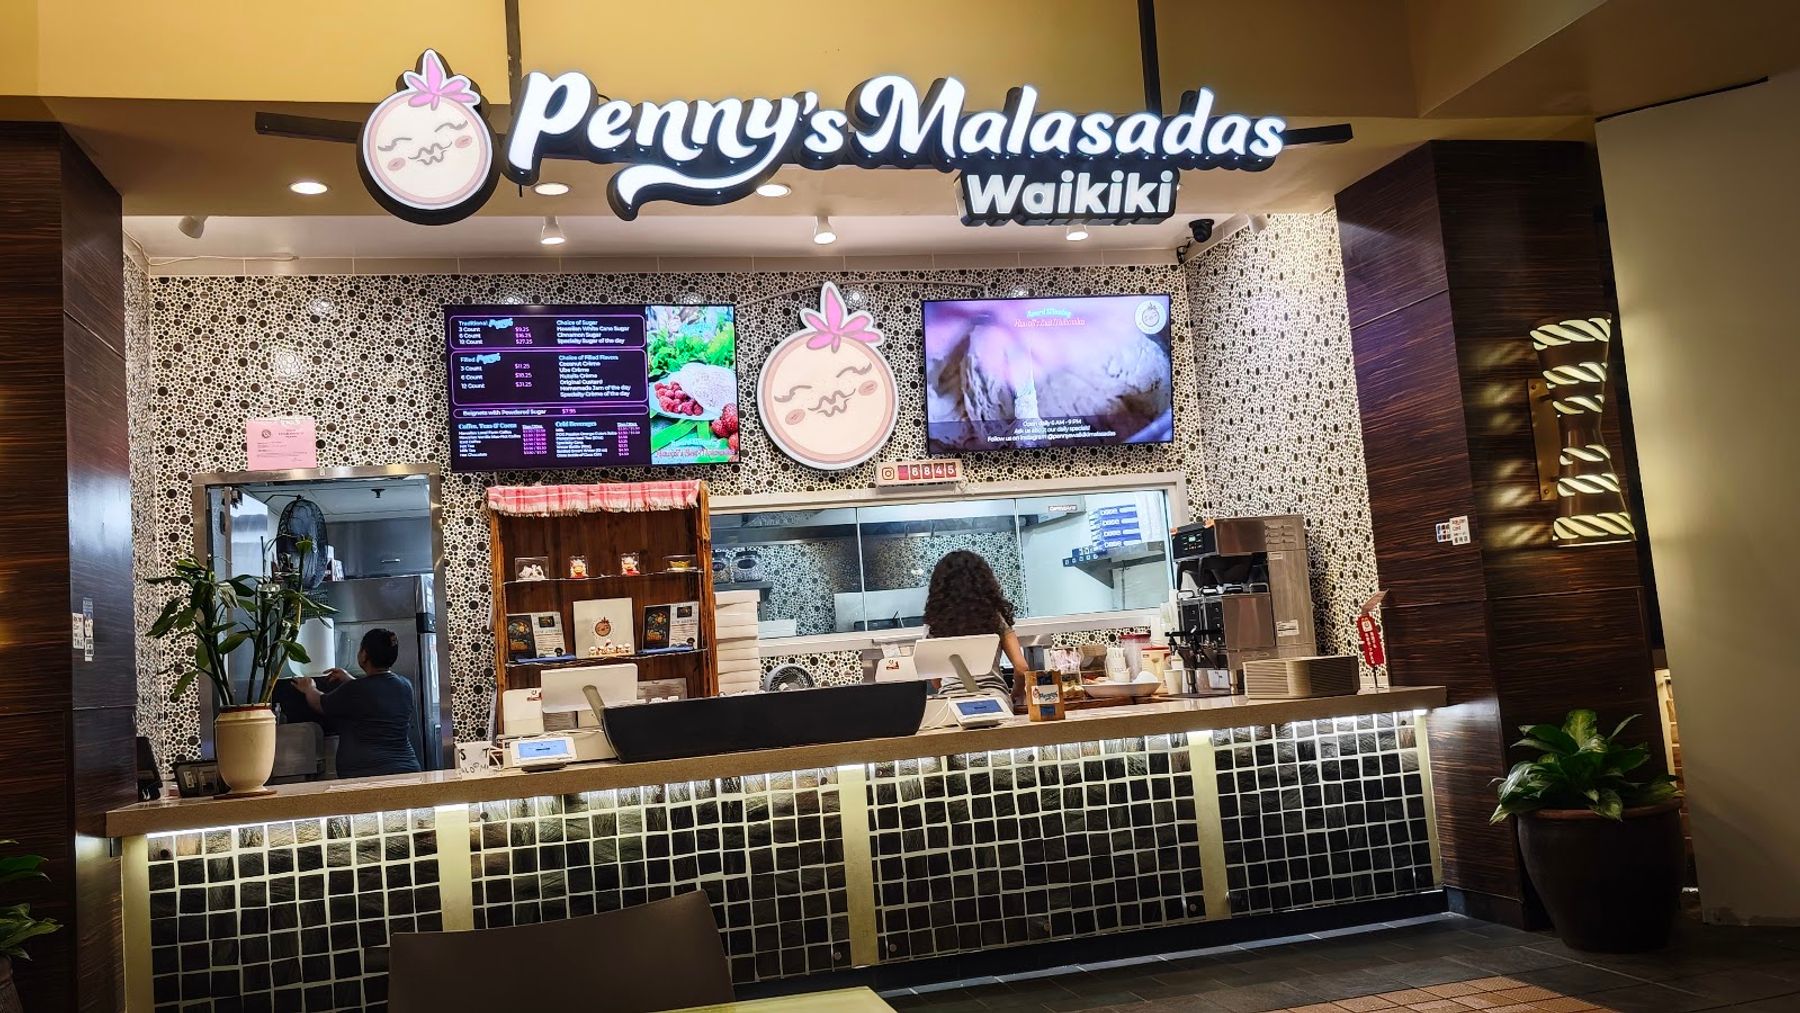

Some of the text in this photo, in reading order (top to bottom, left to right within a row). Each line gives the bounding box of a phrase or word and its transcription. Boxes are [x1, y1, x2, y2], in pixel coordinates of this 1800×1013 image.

[507, 70, 1287, 206] Penny's Malasadas
[966, 170, 1173, 214] Waikiki
[530, 408, 547, 416] Sugar
[911, 464, 954, 476] 6845
